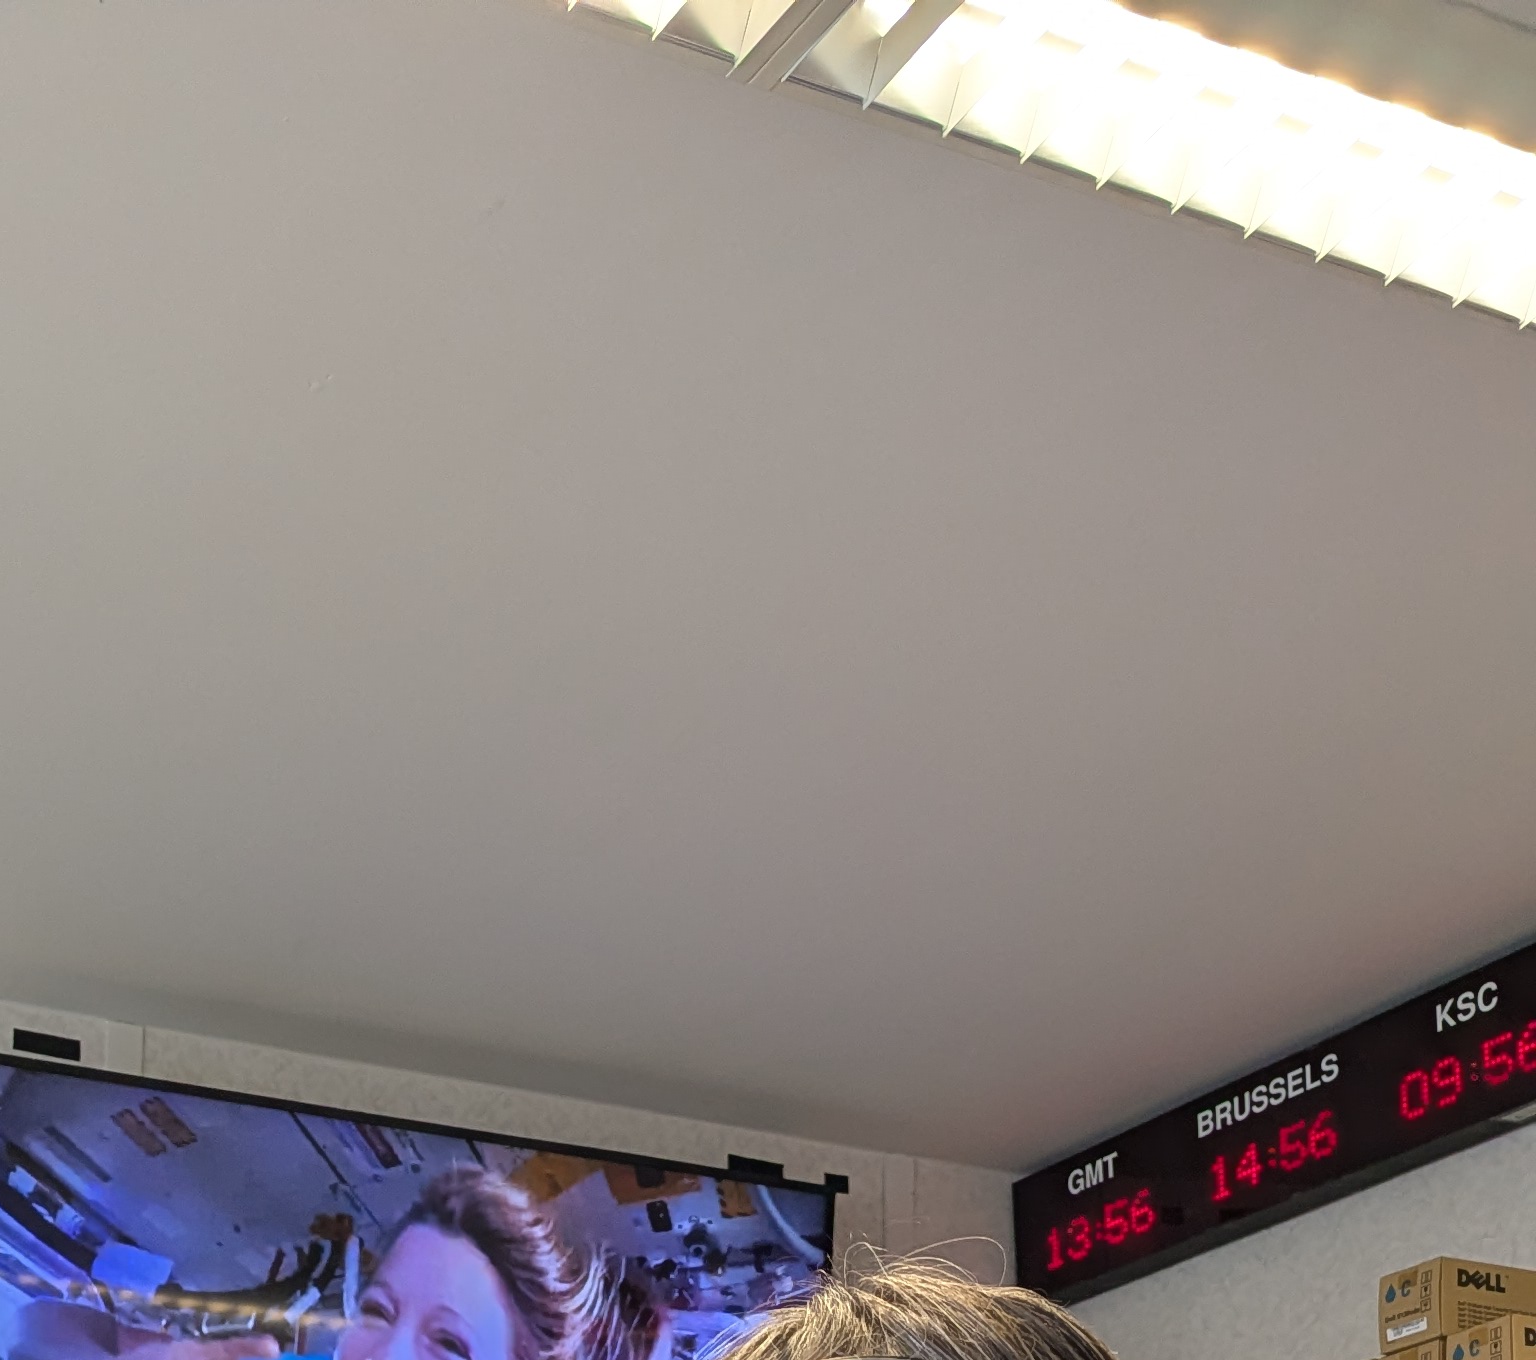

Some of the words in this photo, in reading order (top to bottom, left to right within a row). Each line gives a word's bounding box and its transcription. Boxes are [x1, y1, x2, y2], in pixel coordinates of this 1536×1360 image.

[1067, 1151, 1119, 1196] GMT
[1196, 1052, 1339, 1139] BRUSSELS
[1434, 980, 1499, 1034] KSC
[1046, 1192, 1157, 1272] 13:56
[1211, 1110, 1338, 1201] 14:56
[1398, 1020, 1536, 1121] 09:56
[1400, 1278, 1411, 1298] C
[1456, 1267, 1506, 1294] DELL
[1468, 1338, 1480, 1357] C
